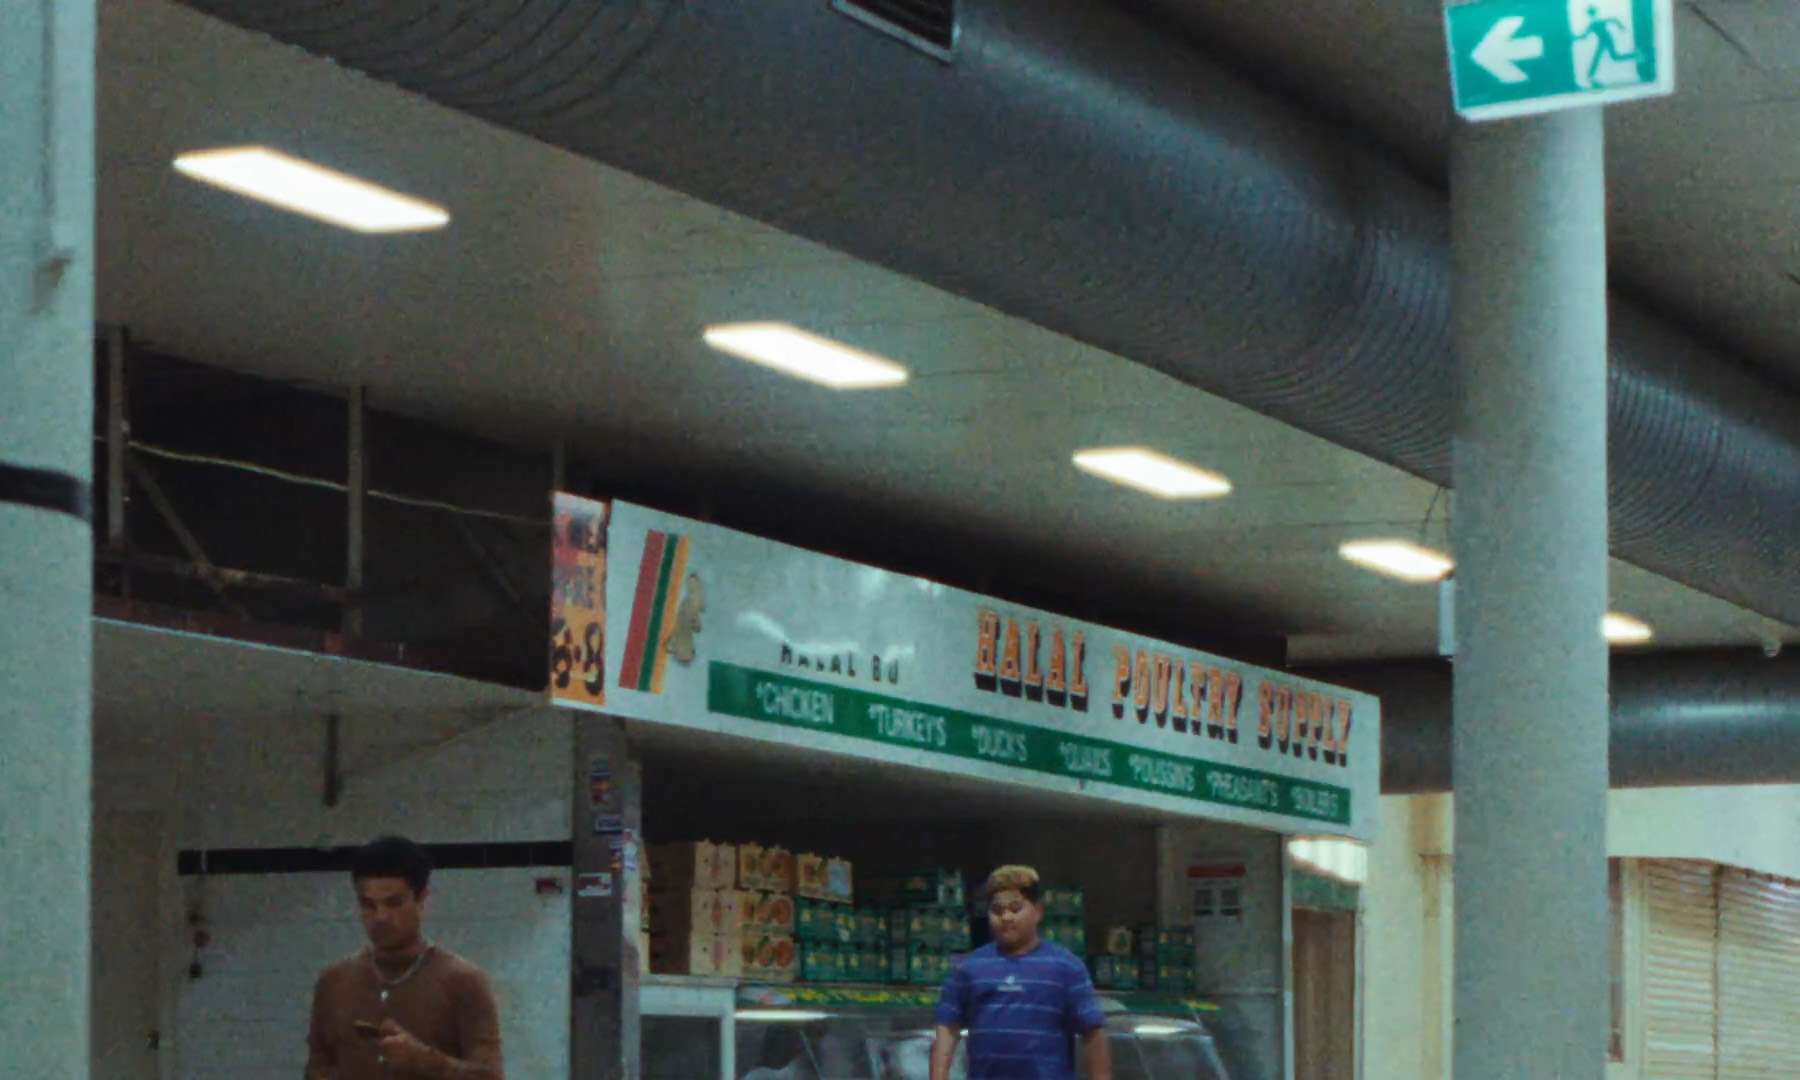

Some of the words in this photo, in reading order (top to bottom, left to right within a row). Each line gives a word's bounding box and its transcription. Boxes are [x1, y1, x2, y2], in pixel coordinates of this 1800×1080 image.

[974, 609, 1088, 713] HALAL
[1111, 643, 1242, 744] POULTRY
[1258, 680, 1352, 767] SUPPLY
